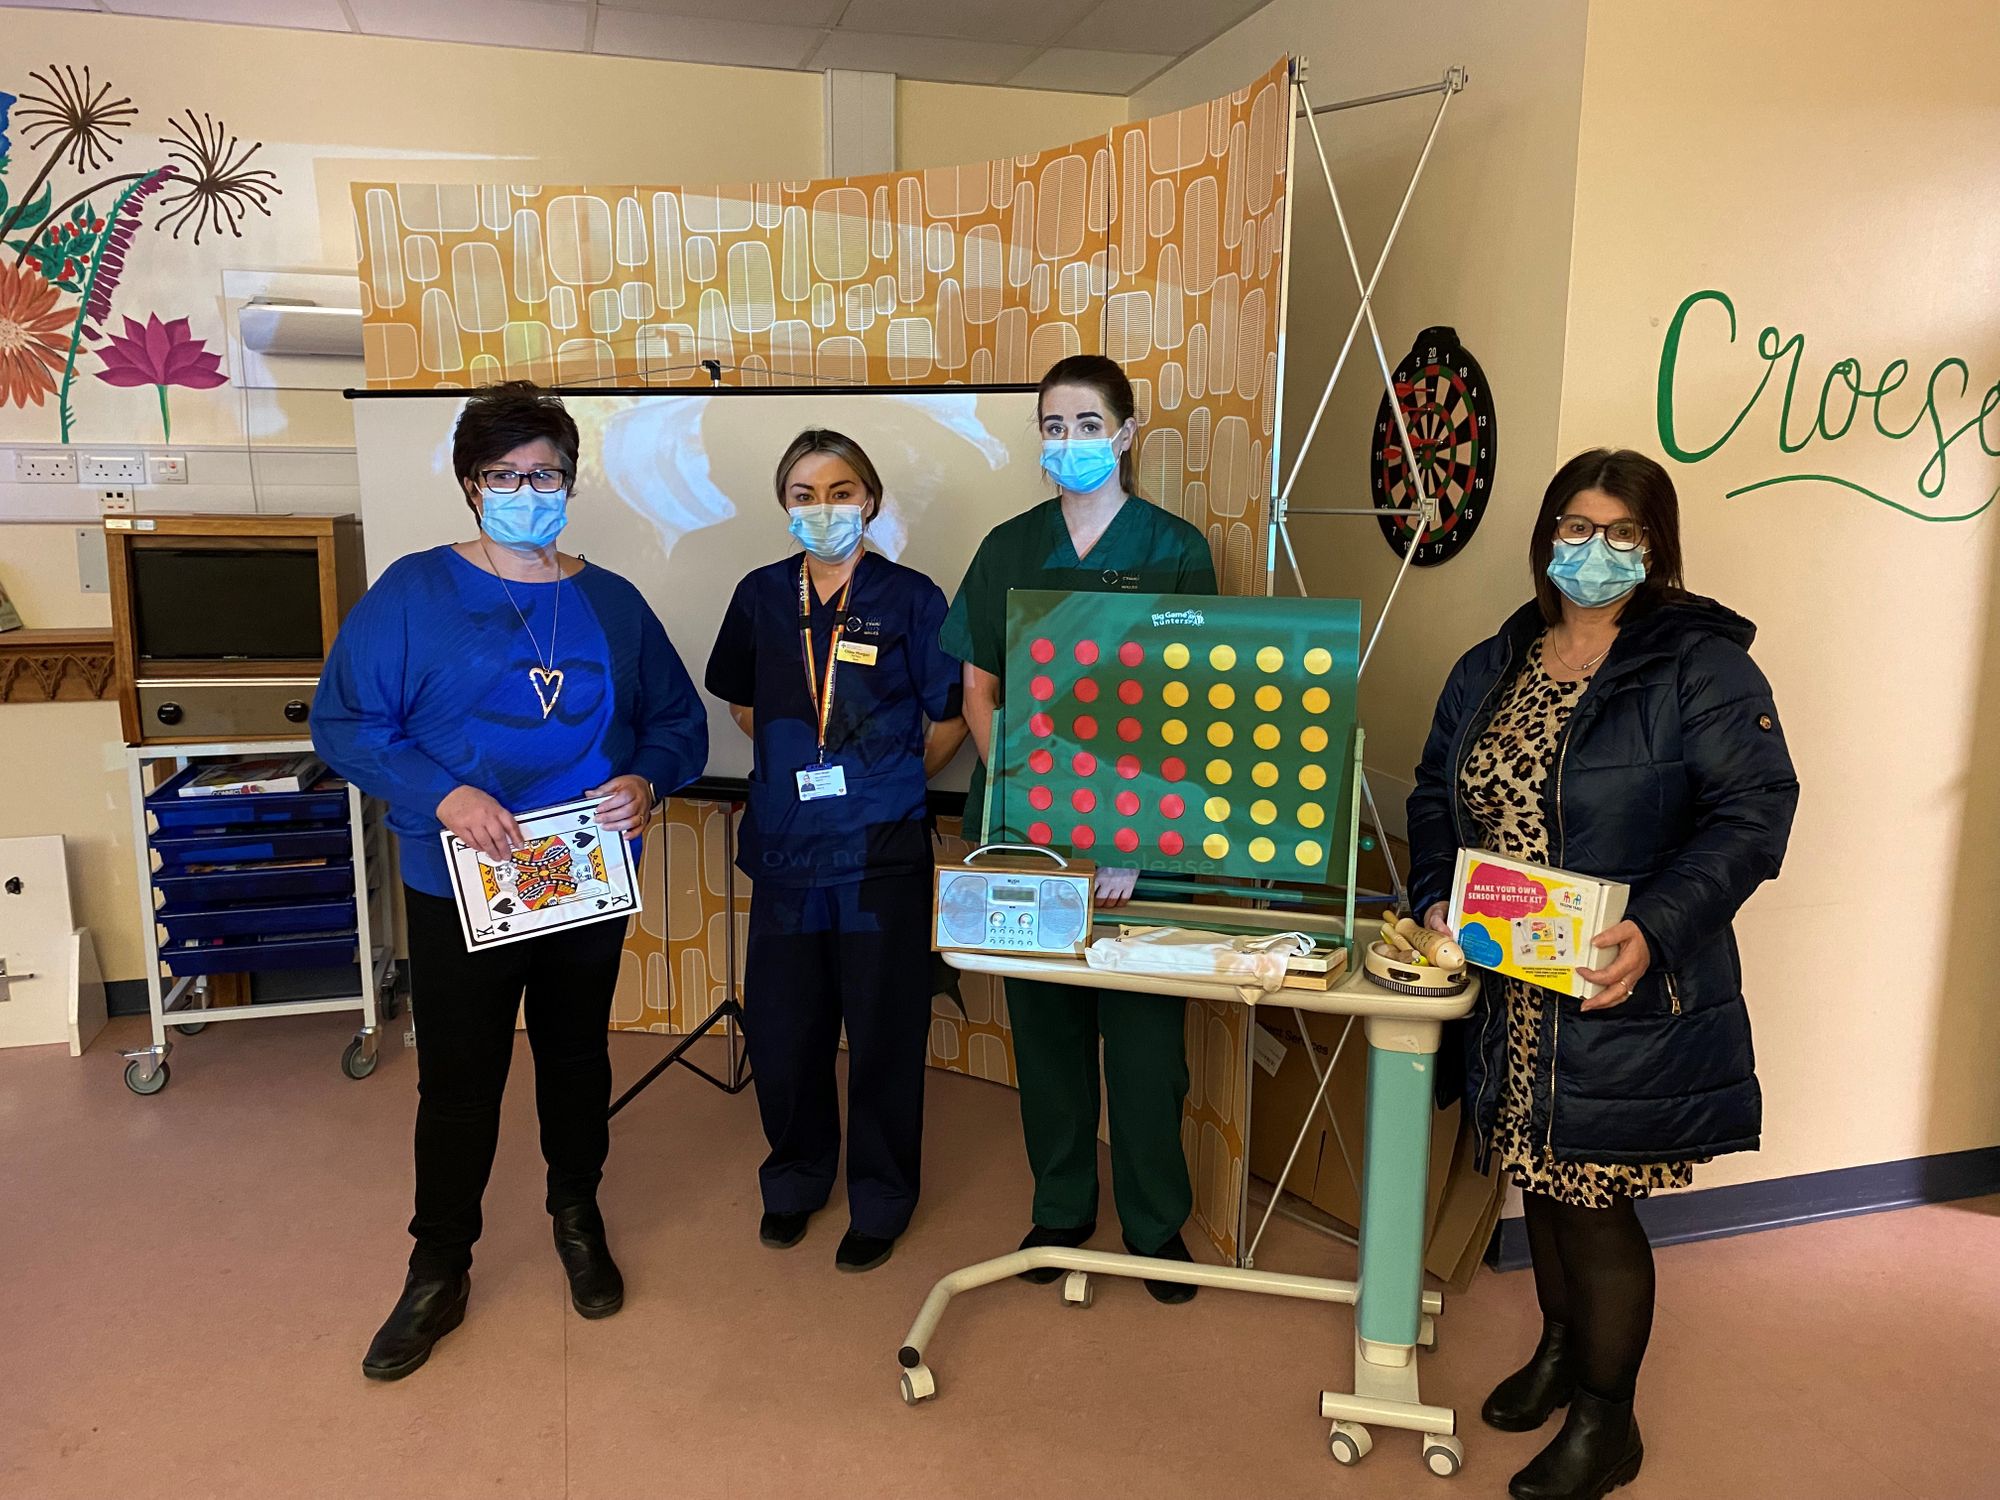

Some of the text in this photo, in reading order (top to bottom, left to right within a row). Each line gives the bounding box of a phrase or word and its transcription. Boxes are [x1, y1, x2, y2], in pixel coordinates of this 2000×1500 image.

[1428, 347, 1437, 357] 20
[1415, 357, 1421, 367] 5
[1445, 353, 1450, 364] 1
[1398, 372, 1406, 381] 12
[1459, 367, 1468, 378] 18
[1471, 387, 1477, 397] 4
[1478, 416, 1487, 427] 13
[1379, 423, 1386, 432] 14
[1376, 451, 1383, 460] 11
[1480, 448, 1486, 459] 6
[1377, 479, 1383, 488] 8
[1475, 478, 1484, 489] 10
[1464, 509, 1473, 520] 15
[1392, 526, 1397, 536] 7
[1452, 531, 1457, 541] 2
[1403, 540, 1411, 551] 19
[1434, 544, 1443, 554] 17
[1419, 548, 1424, 558] 3
[1151, 611, 1188, 621] Big Game
[1152, 617, 1189, 627] hunters
[1473, 884, 1537, 895] MAKE YOUR OWN
[611, 893, 630, 907] K
[1468, 892, 1543, 905] SENSORY BOTTLE KIT
[476, 924, 495, 938] K
[1285, 1030, 1329, 1056] Serces
